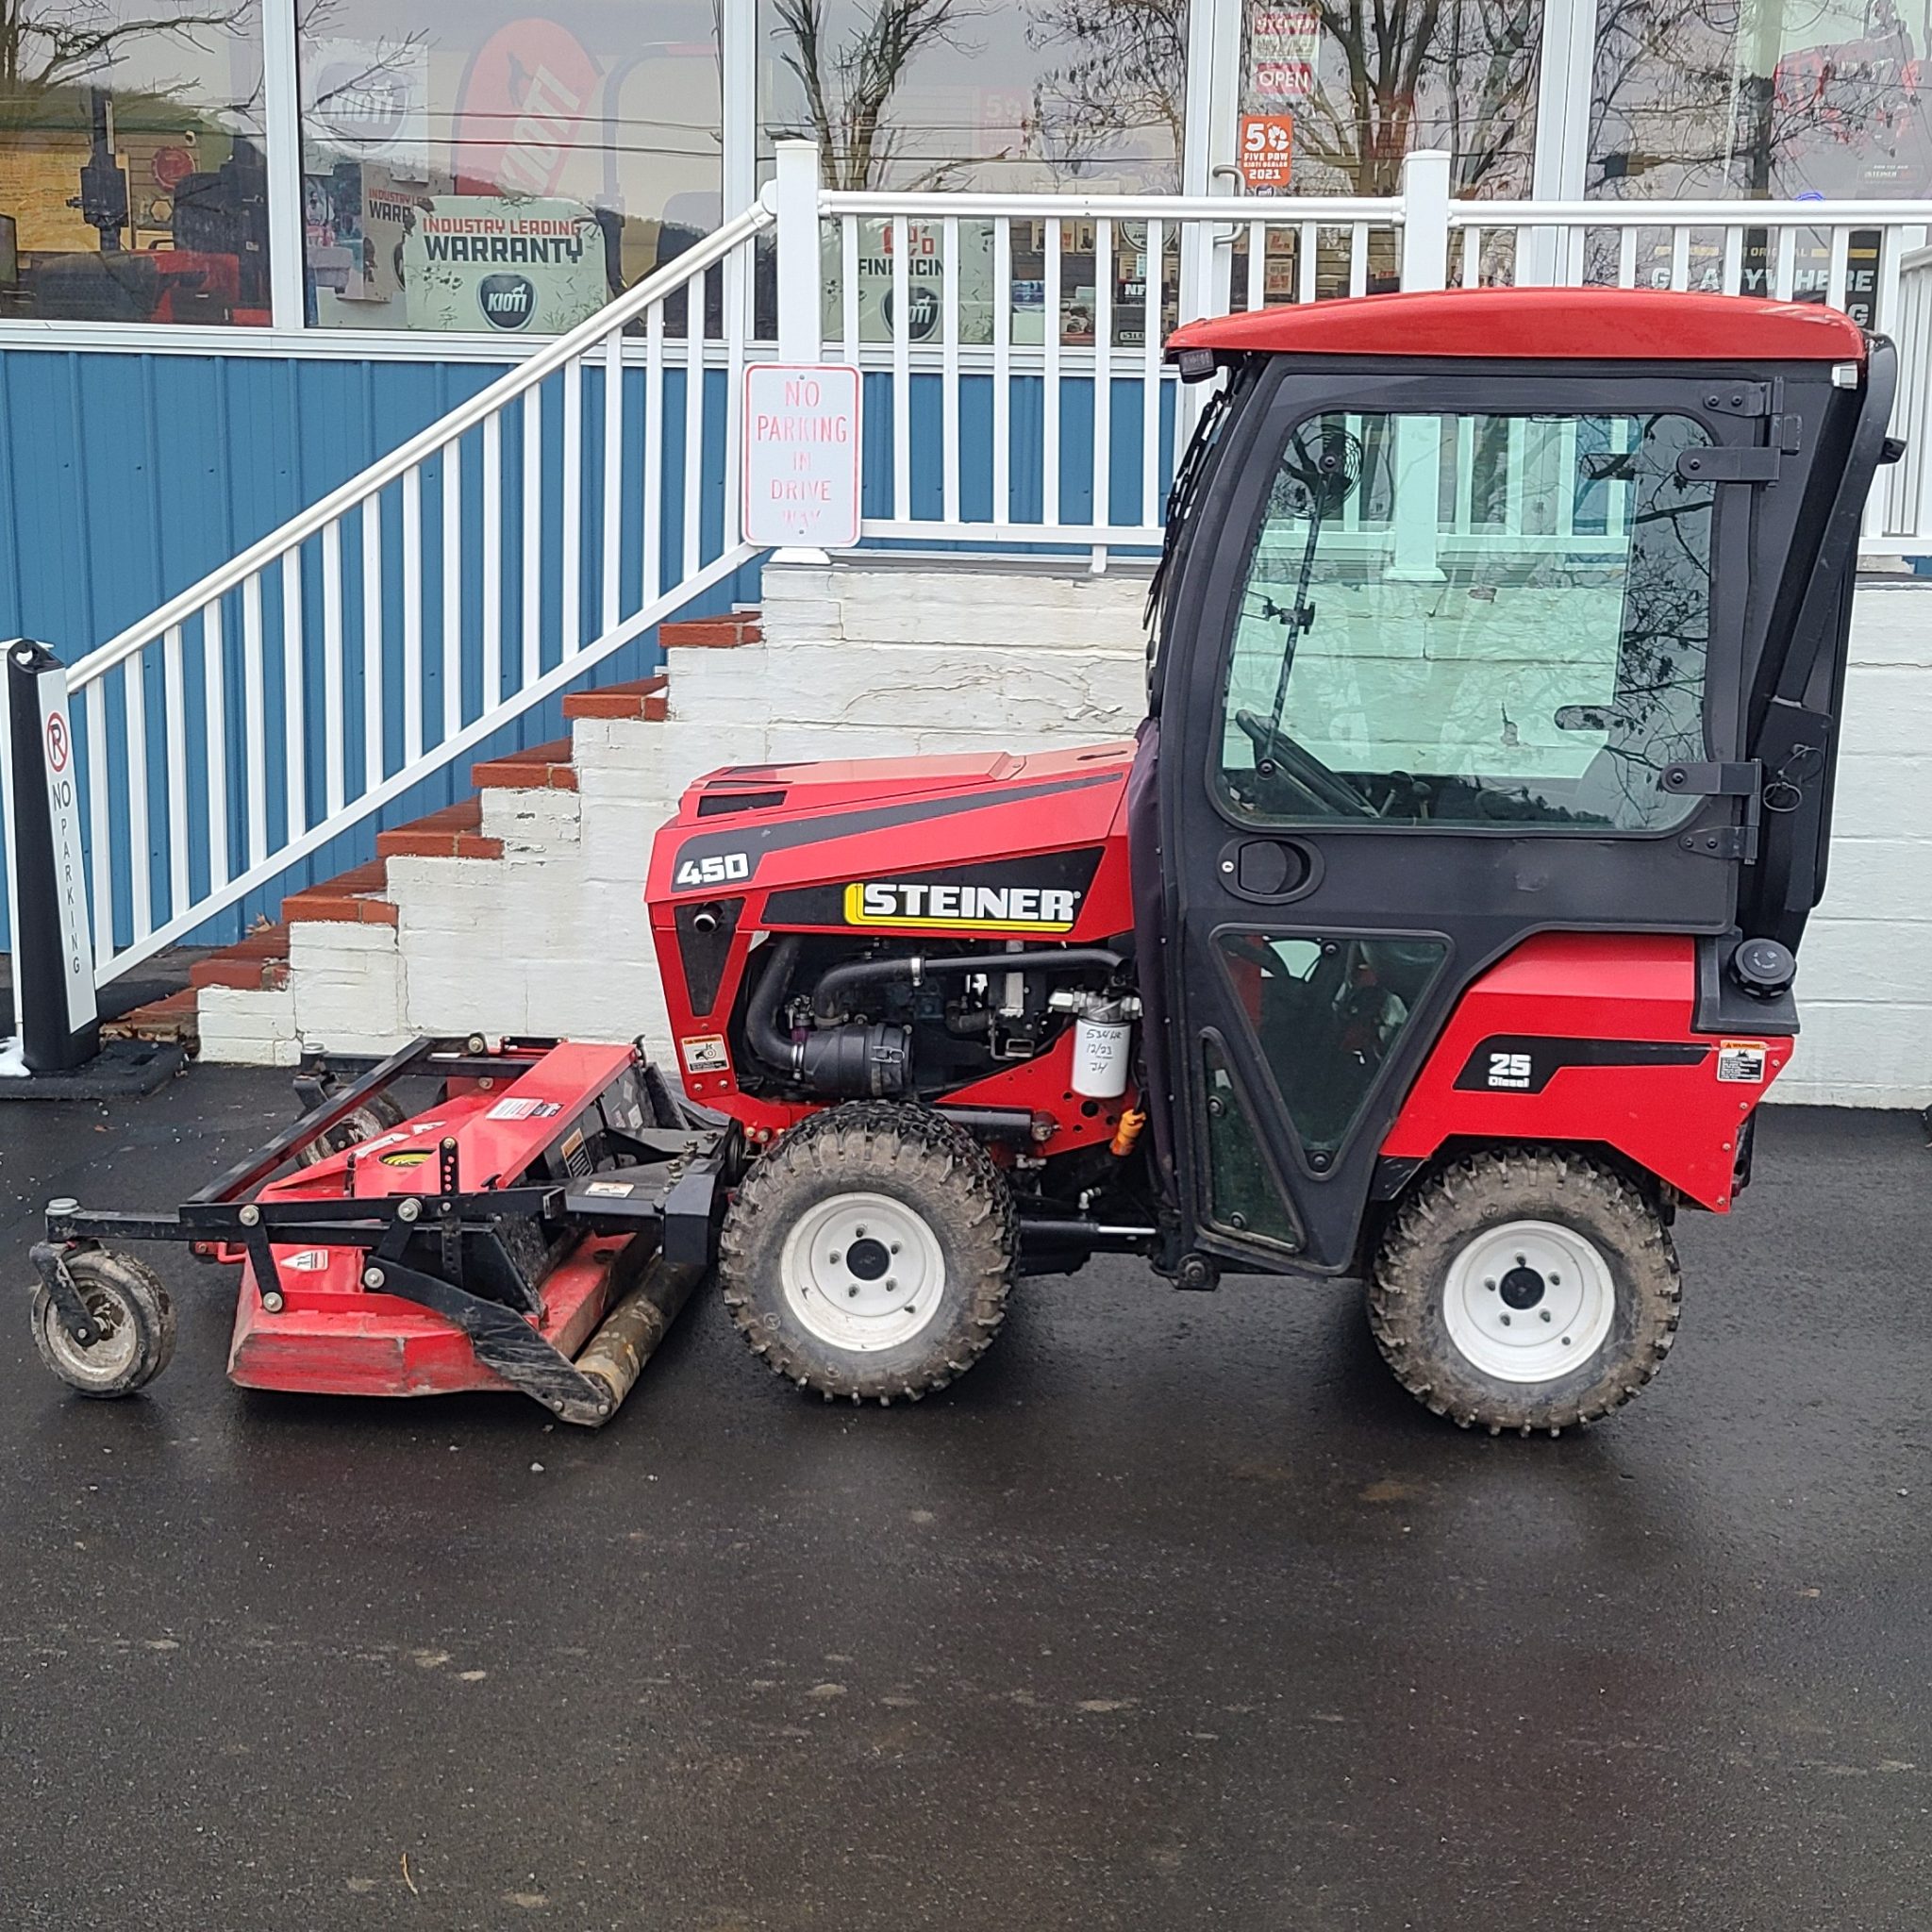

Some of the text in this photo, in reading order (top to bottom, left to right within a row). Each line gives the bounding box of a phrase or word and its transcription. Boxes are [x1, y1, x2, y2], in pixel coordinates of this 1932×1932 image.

[1259, 70, 1308, 88] OPEN
[1243, 152, 1289, 160] FIVE PAW
[1248, 169, 1281, 179] 2021
[369, 189, 411, 205] INDUSTRY
[423, 217, 582, 237] INDUSTRY LEADING
[424, 235, 583, 264] WARRANTY
[488, 291, 527, 312] KIOTI
[785, 380, 820, 408] NO
[758, 415, 847, 442] PARKING
[793, 451, 811, 472] IN
[771, 478, 832, 501] DRIVE
[52, 779, 72, 811] NO
[676, 852, 749, 885] 450
[60, 817, 81, 974] PARKING
[1489, 1053, 1532, 1076] 25
[1488, 1075, 1530, 1088] Diesel
